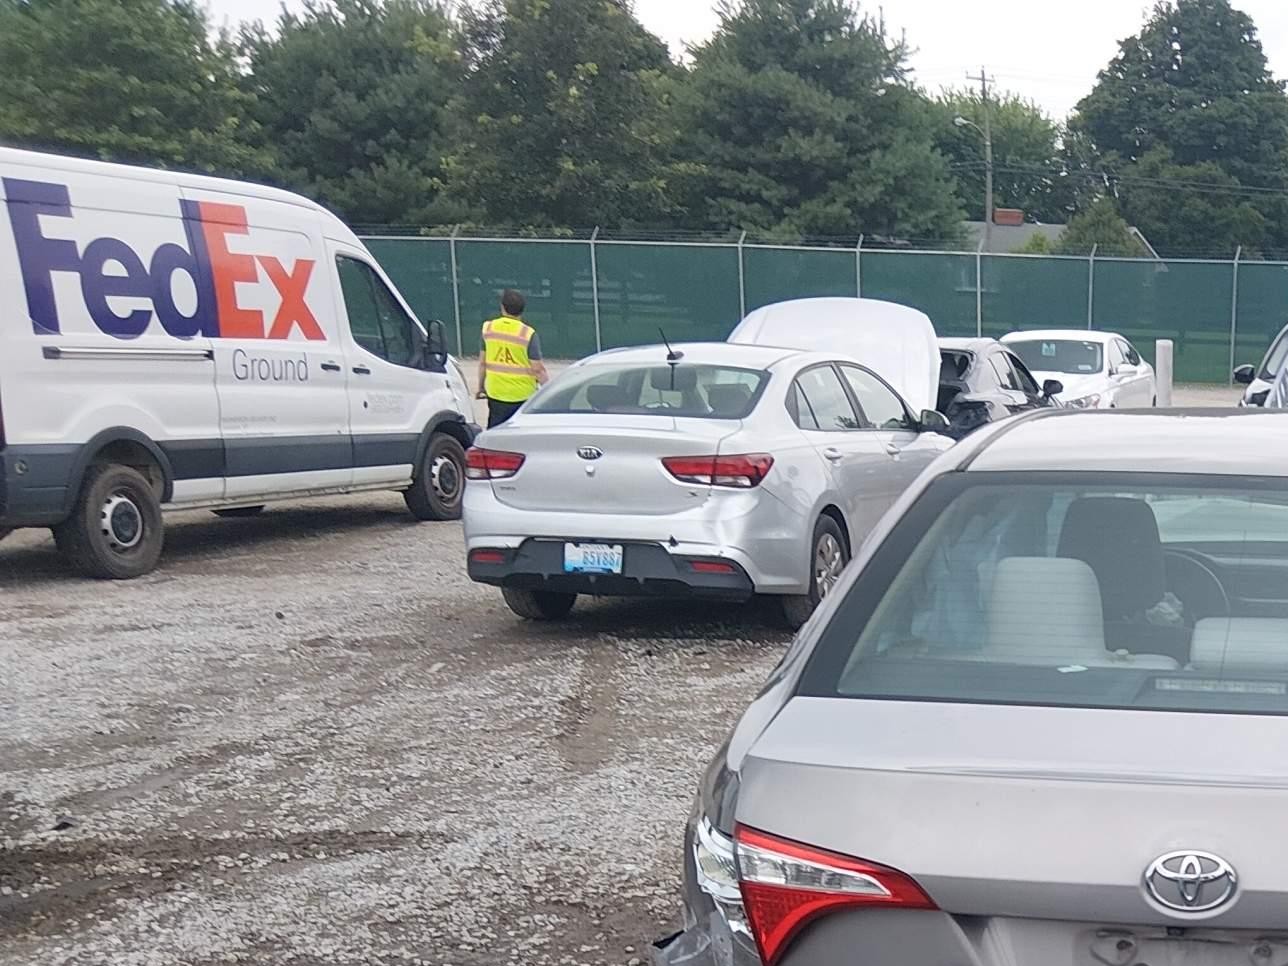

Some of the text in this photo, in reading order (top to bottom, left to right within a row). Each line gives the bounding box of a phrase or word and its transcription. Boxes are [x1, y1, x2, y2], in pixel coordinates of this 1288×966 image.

[2, 177, 327, 341] FedEx
[232, 348, 309, 382] Ground
[578, 447, 600, 459] KIA
